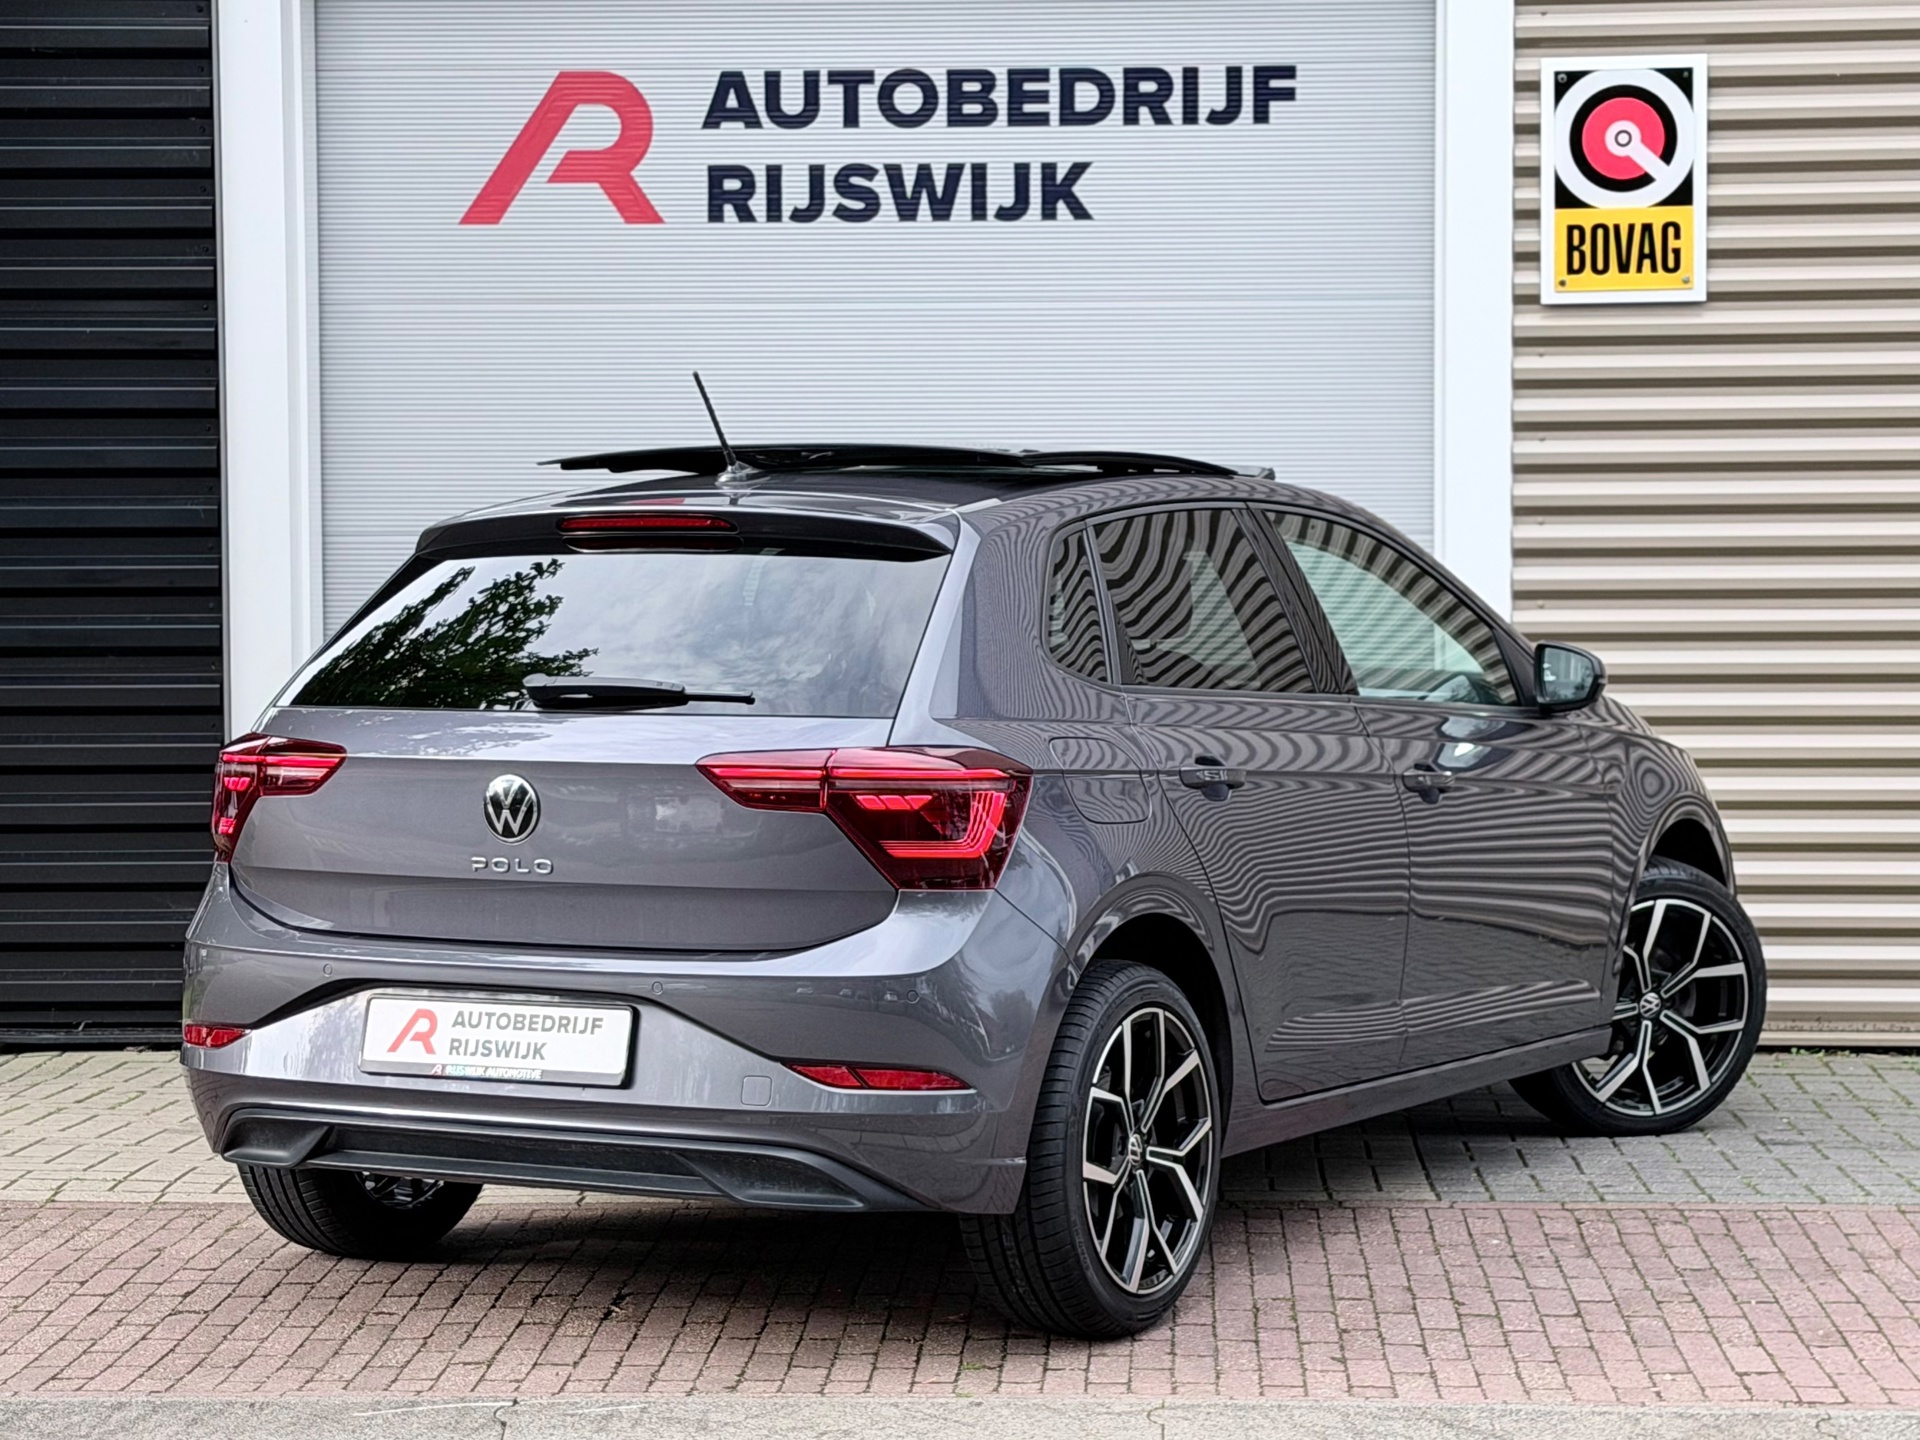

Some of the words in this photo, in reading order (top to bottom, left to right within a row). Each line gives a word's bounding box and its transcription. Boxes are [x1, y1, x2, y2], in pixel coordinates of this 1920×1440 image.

[701, 65, 1297, 129] AUTOBEDRIJF
[706, 161, 1094, 224] RIJSWIJK
[1566, 221, 1682, 276] BOVAG
[471, 856, 554, 875] POLO
[451, 1010, 604, 1036] AUTOBEDRIJF
[448, 1038, 548, 1061] RIJSWIJK
[486, 1066, 542, 1080] AUTOMOTIVE
